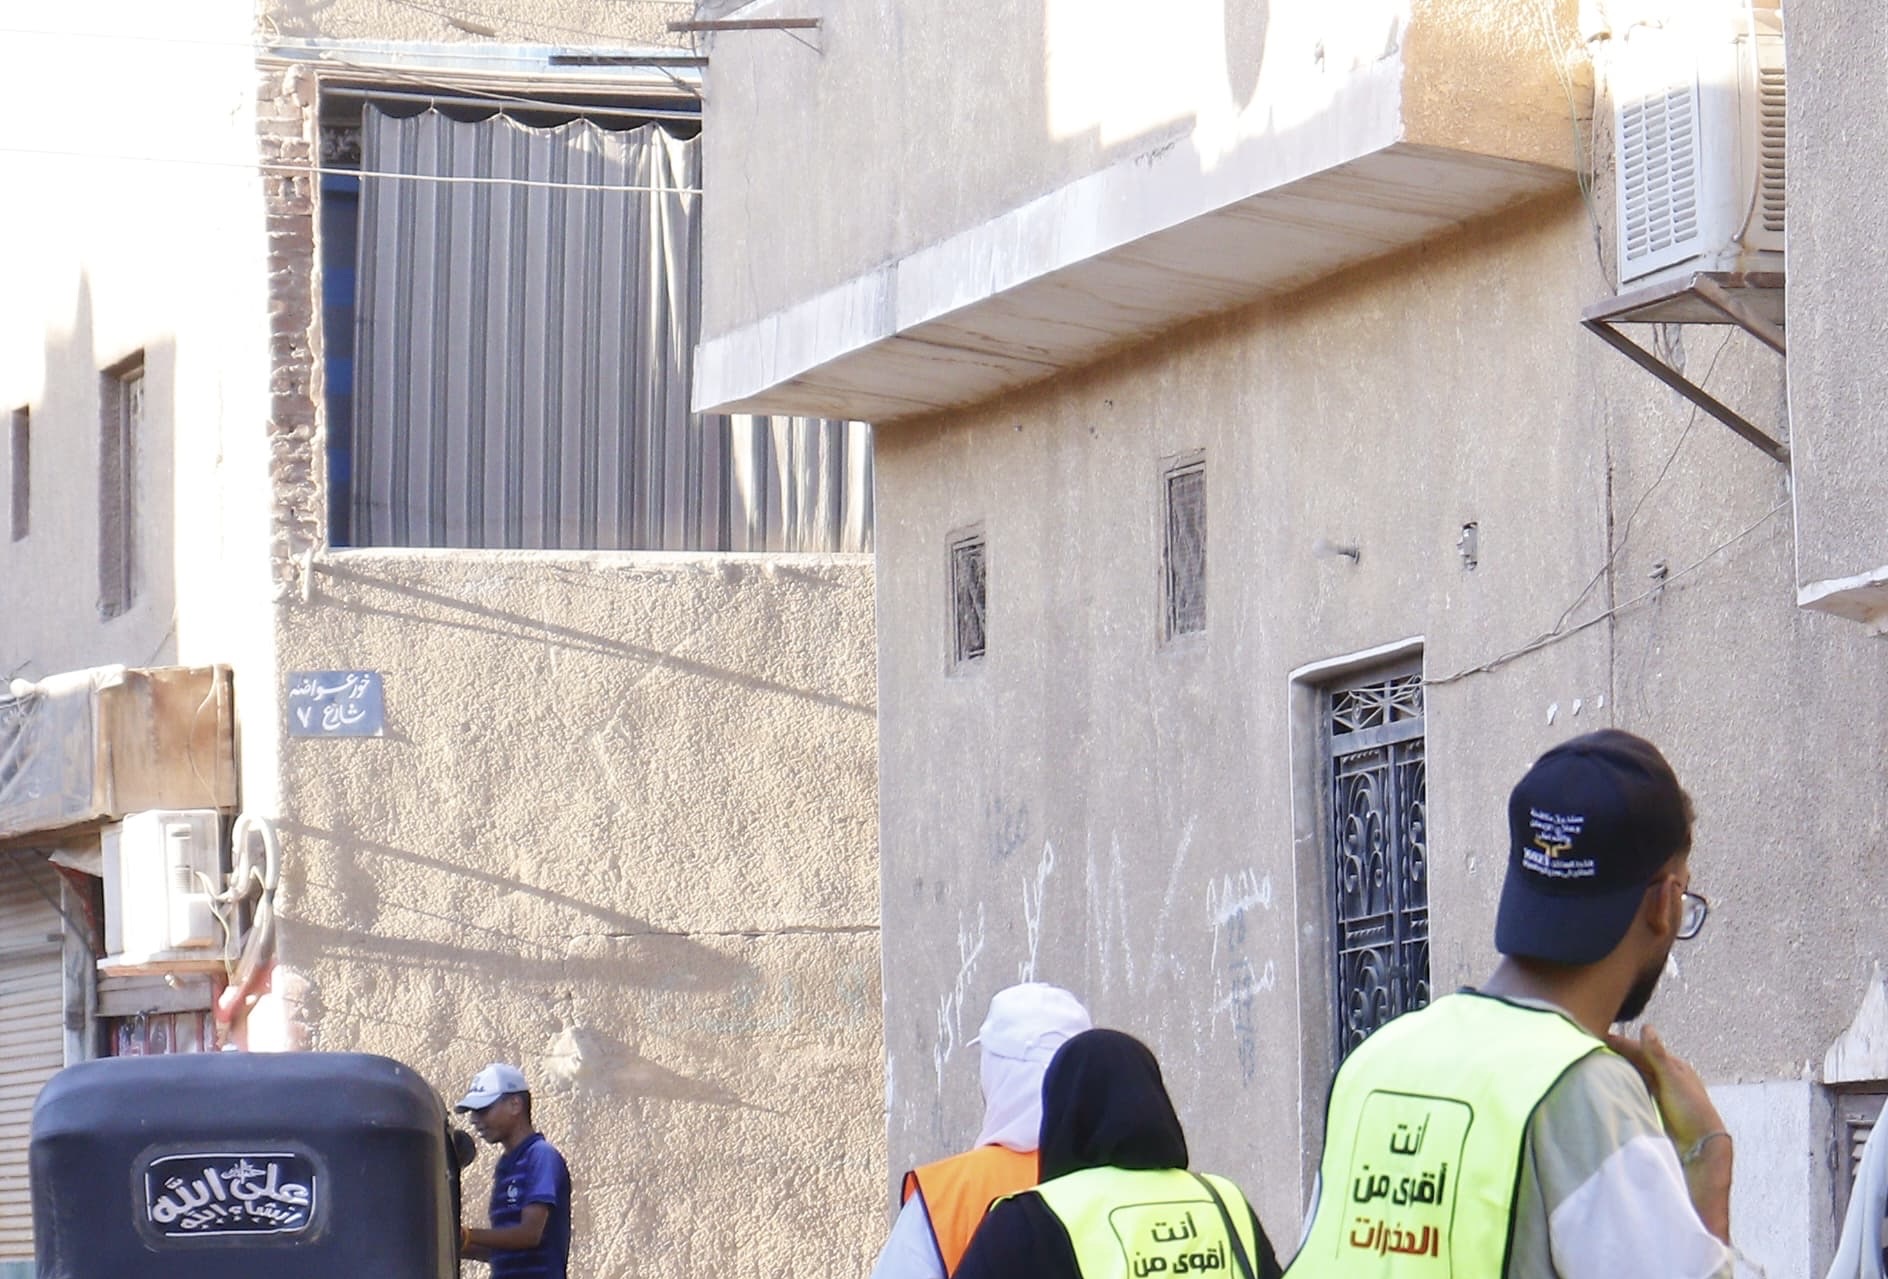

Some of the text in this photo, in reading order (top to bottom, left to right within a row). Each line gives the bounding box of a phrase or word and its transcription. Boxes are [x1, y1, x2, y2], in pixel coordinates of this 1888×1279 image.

[322, 703, 366, 731] شارع
[152, 1167, 226, 1223] الله
[1352, 1163, 1391, 1204] من
[1349, 1216, 1440, 1258] المخرات
[1132, 1251, 1168, 1279] من
